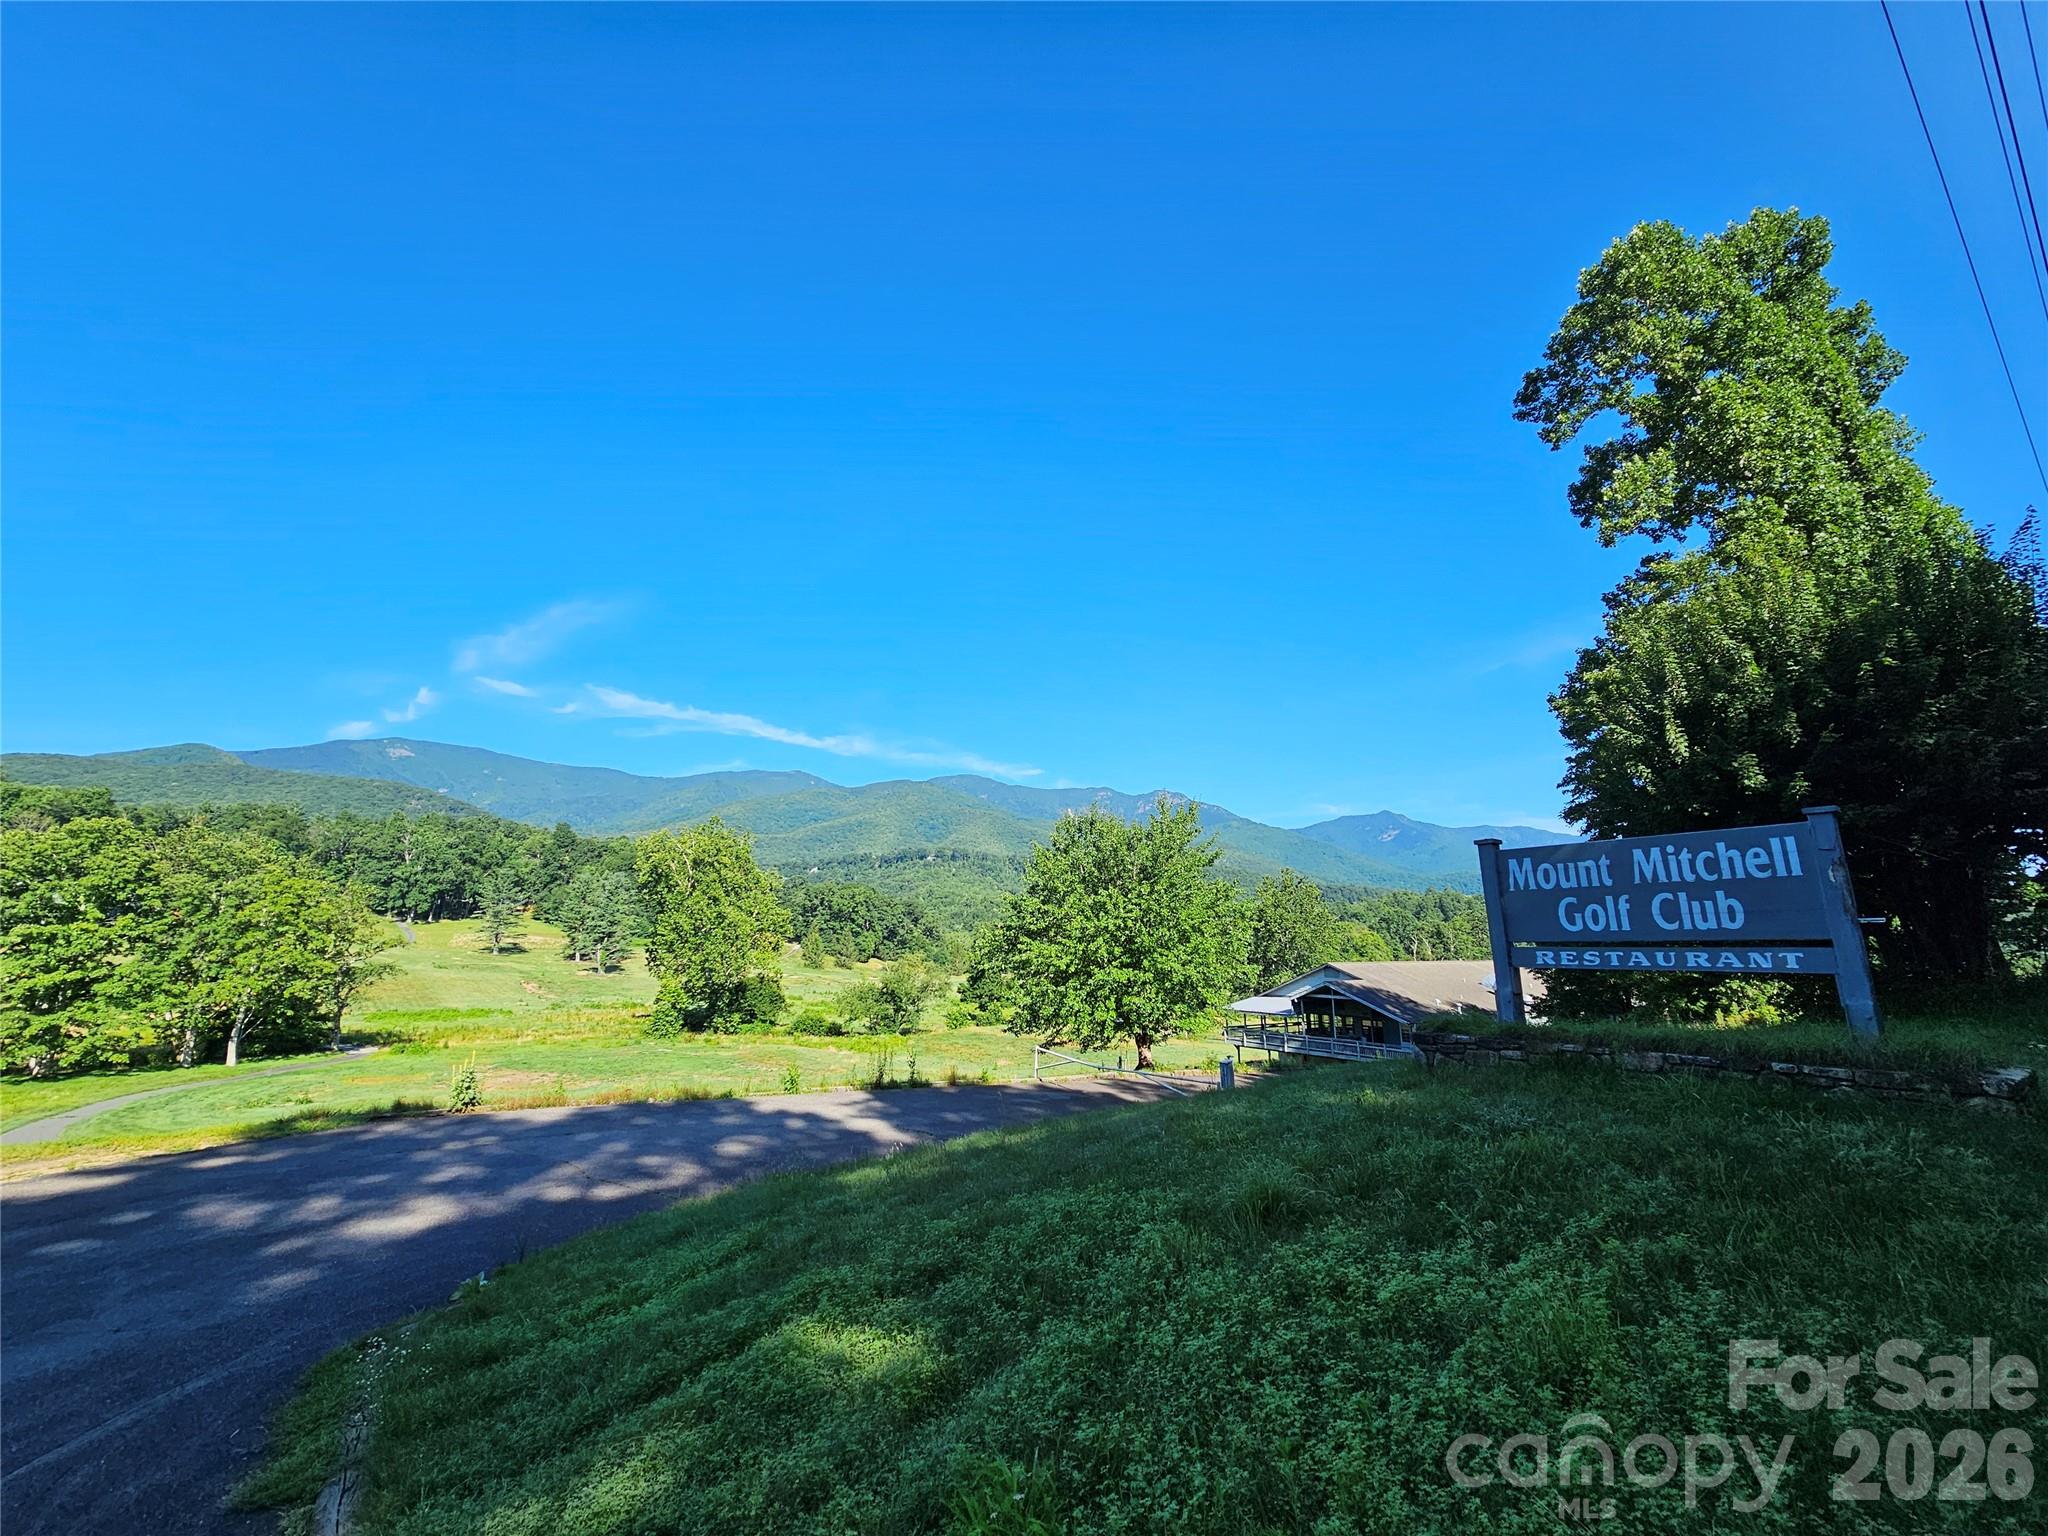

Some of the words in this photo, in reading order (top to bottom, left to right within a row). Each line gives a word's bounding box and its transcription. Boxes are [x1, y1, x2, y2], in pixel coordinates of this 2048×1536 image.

[1508, 854, 1613, 892] Mount
[1633, 835, 1804, 885] Mitchell
[1558, 894, 1632, 933] Golf
[1651, 890, 1745, 930] Club
[1535, 950, 1805, 970] RESTAURANT
